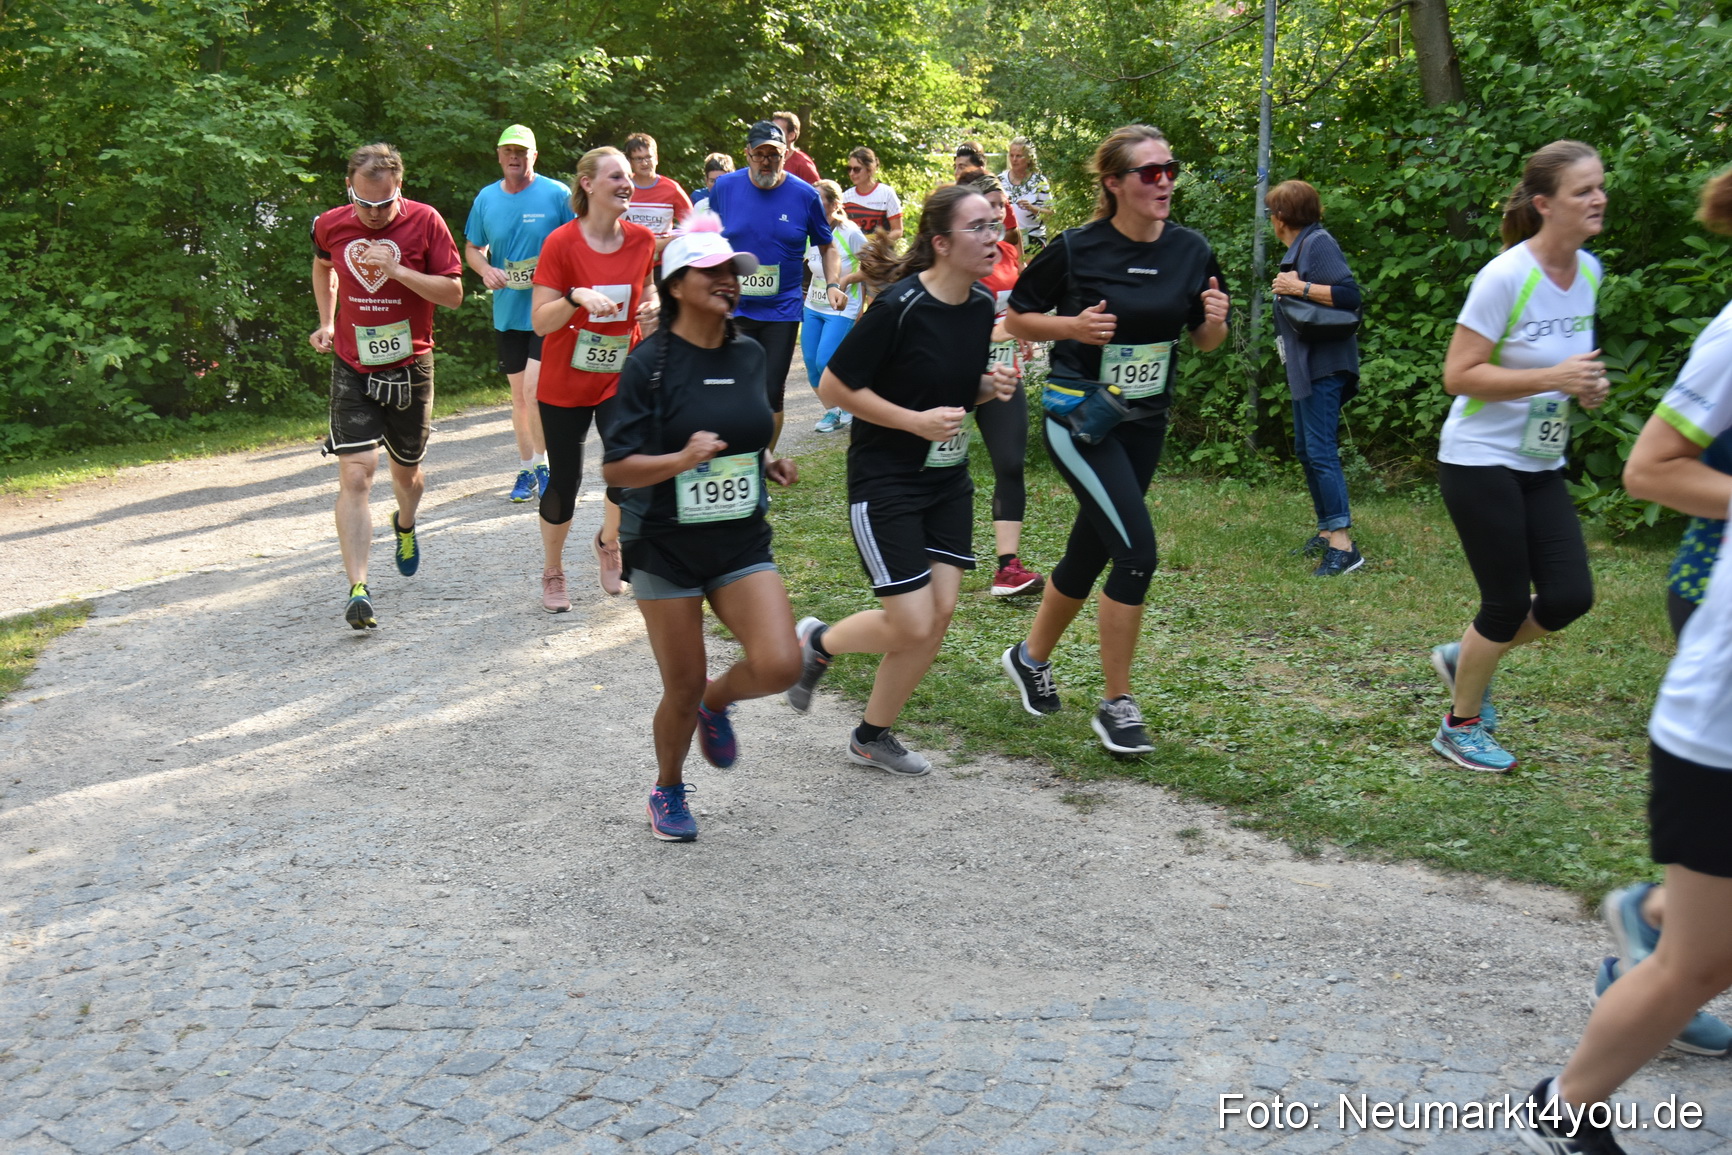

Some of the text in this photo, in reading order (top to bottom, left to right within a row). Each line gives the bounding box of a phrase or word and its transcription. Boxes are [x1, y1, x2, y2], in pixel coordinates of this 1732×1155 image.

[741, 275, 774, 287] 2030
[348, 295, 402, 305] Steuerberatung
[369, 337, 400, 354] 696
[586, 347, 618, 363] 535
[1111, 362, 1161, 383] 1982
[689, 477, 749, 505] 1989
